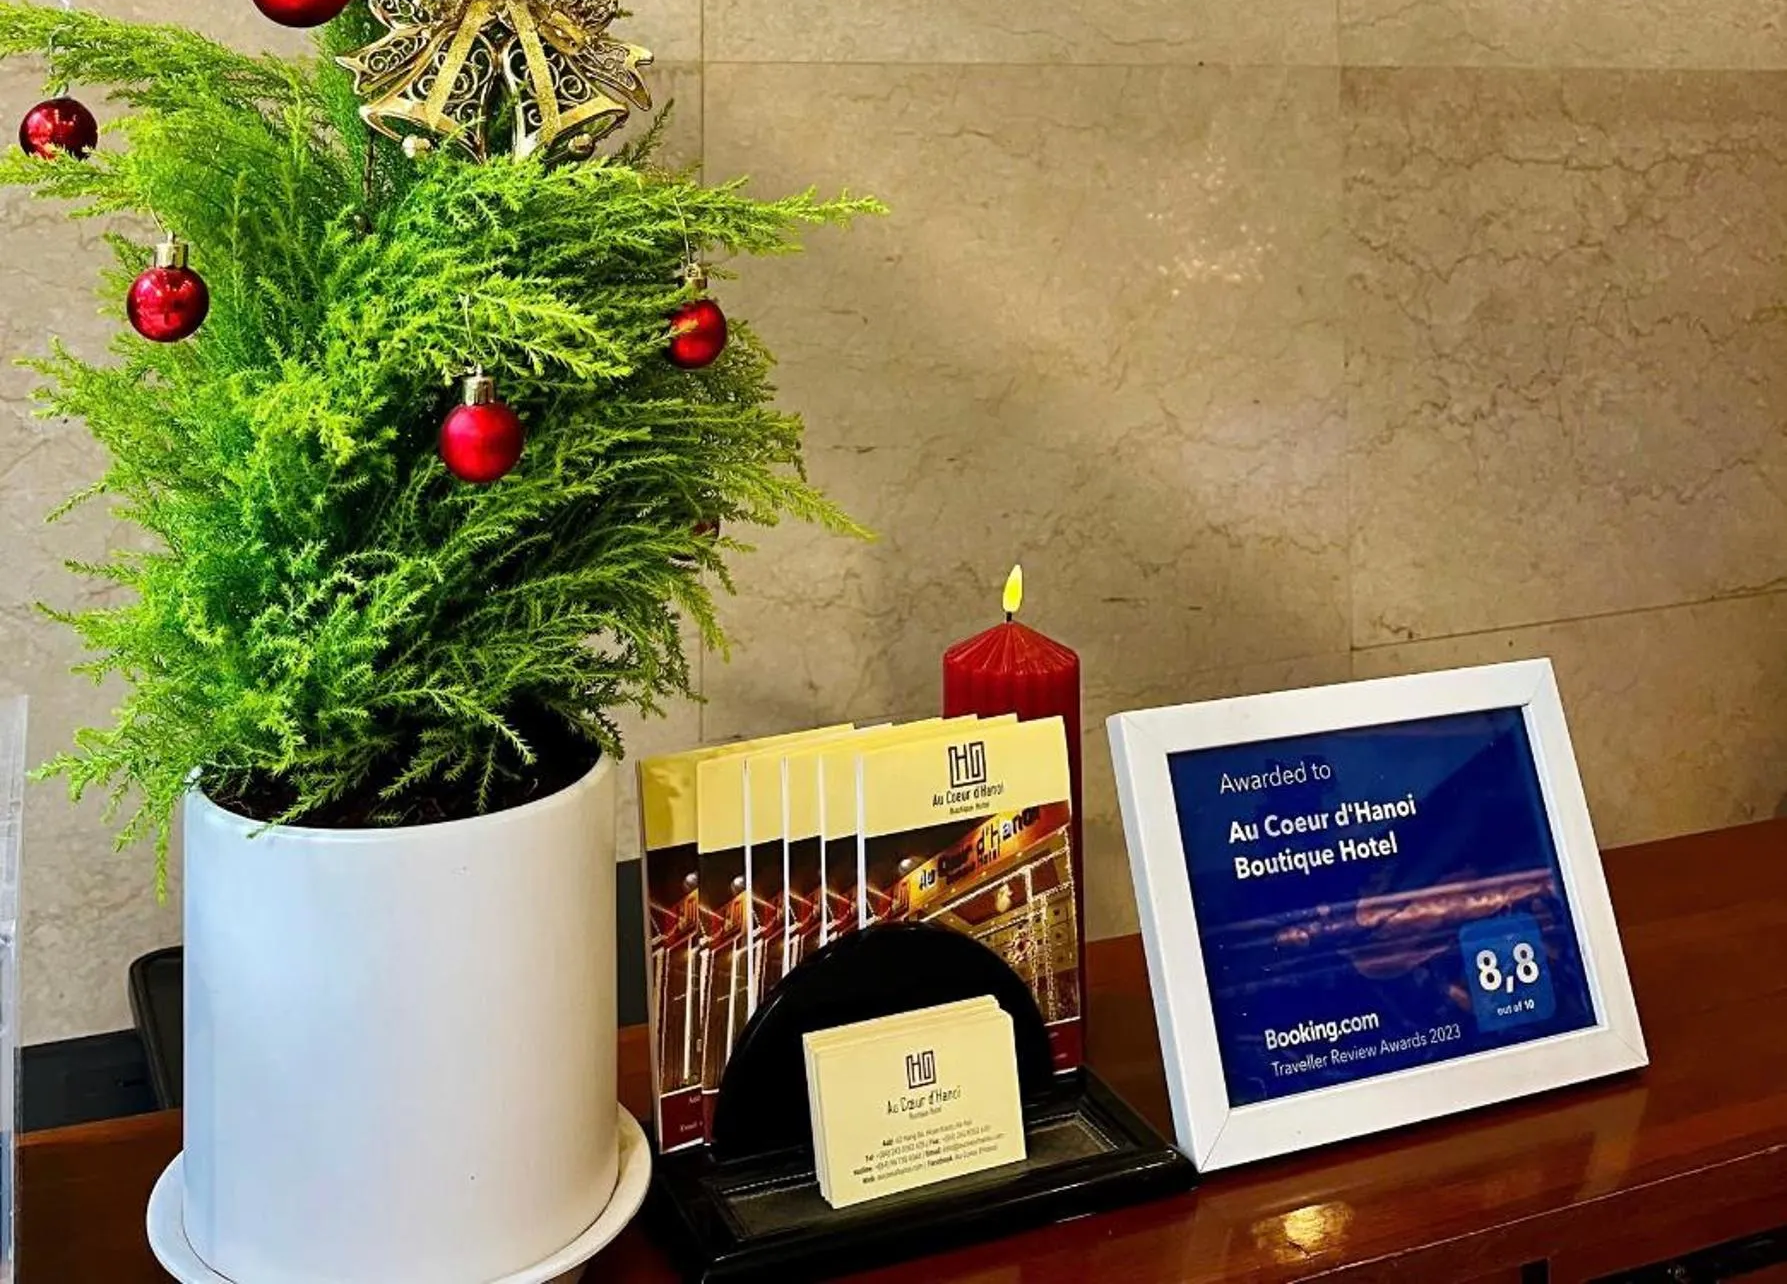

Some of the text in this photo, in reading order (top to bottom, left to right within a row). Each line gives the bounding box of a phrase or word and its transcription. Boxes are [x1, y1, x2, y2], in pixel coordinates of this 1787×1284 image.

[1220, 761, 1331, 795] Awarded to
[1228, 793, 1417, 844] Au Coeur d'Hanoi
[1234, 830, 1398, 880] Boutique Hotel
[1476, 942, 1539, 993] 8,8
[1265, 1012, 1379, 1050] Booking.com
[1497, 999, 1535, 1016] out of 10
[1271, 1023, 1461, 1077] Traveller Review Awards 2023
